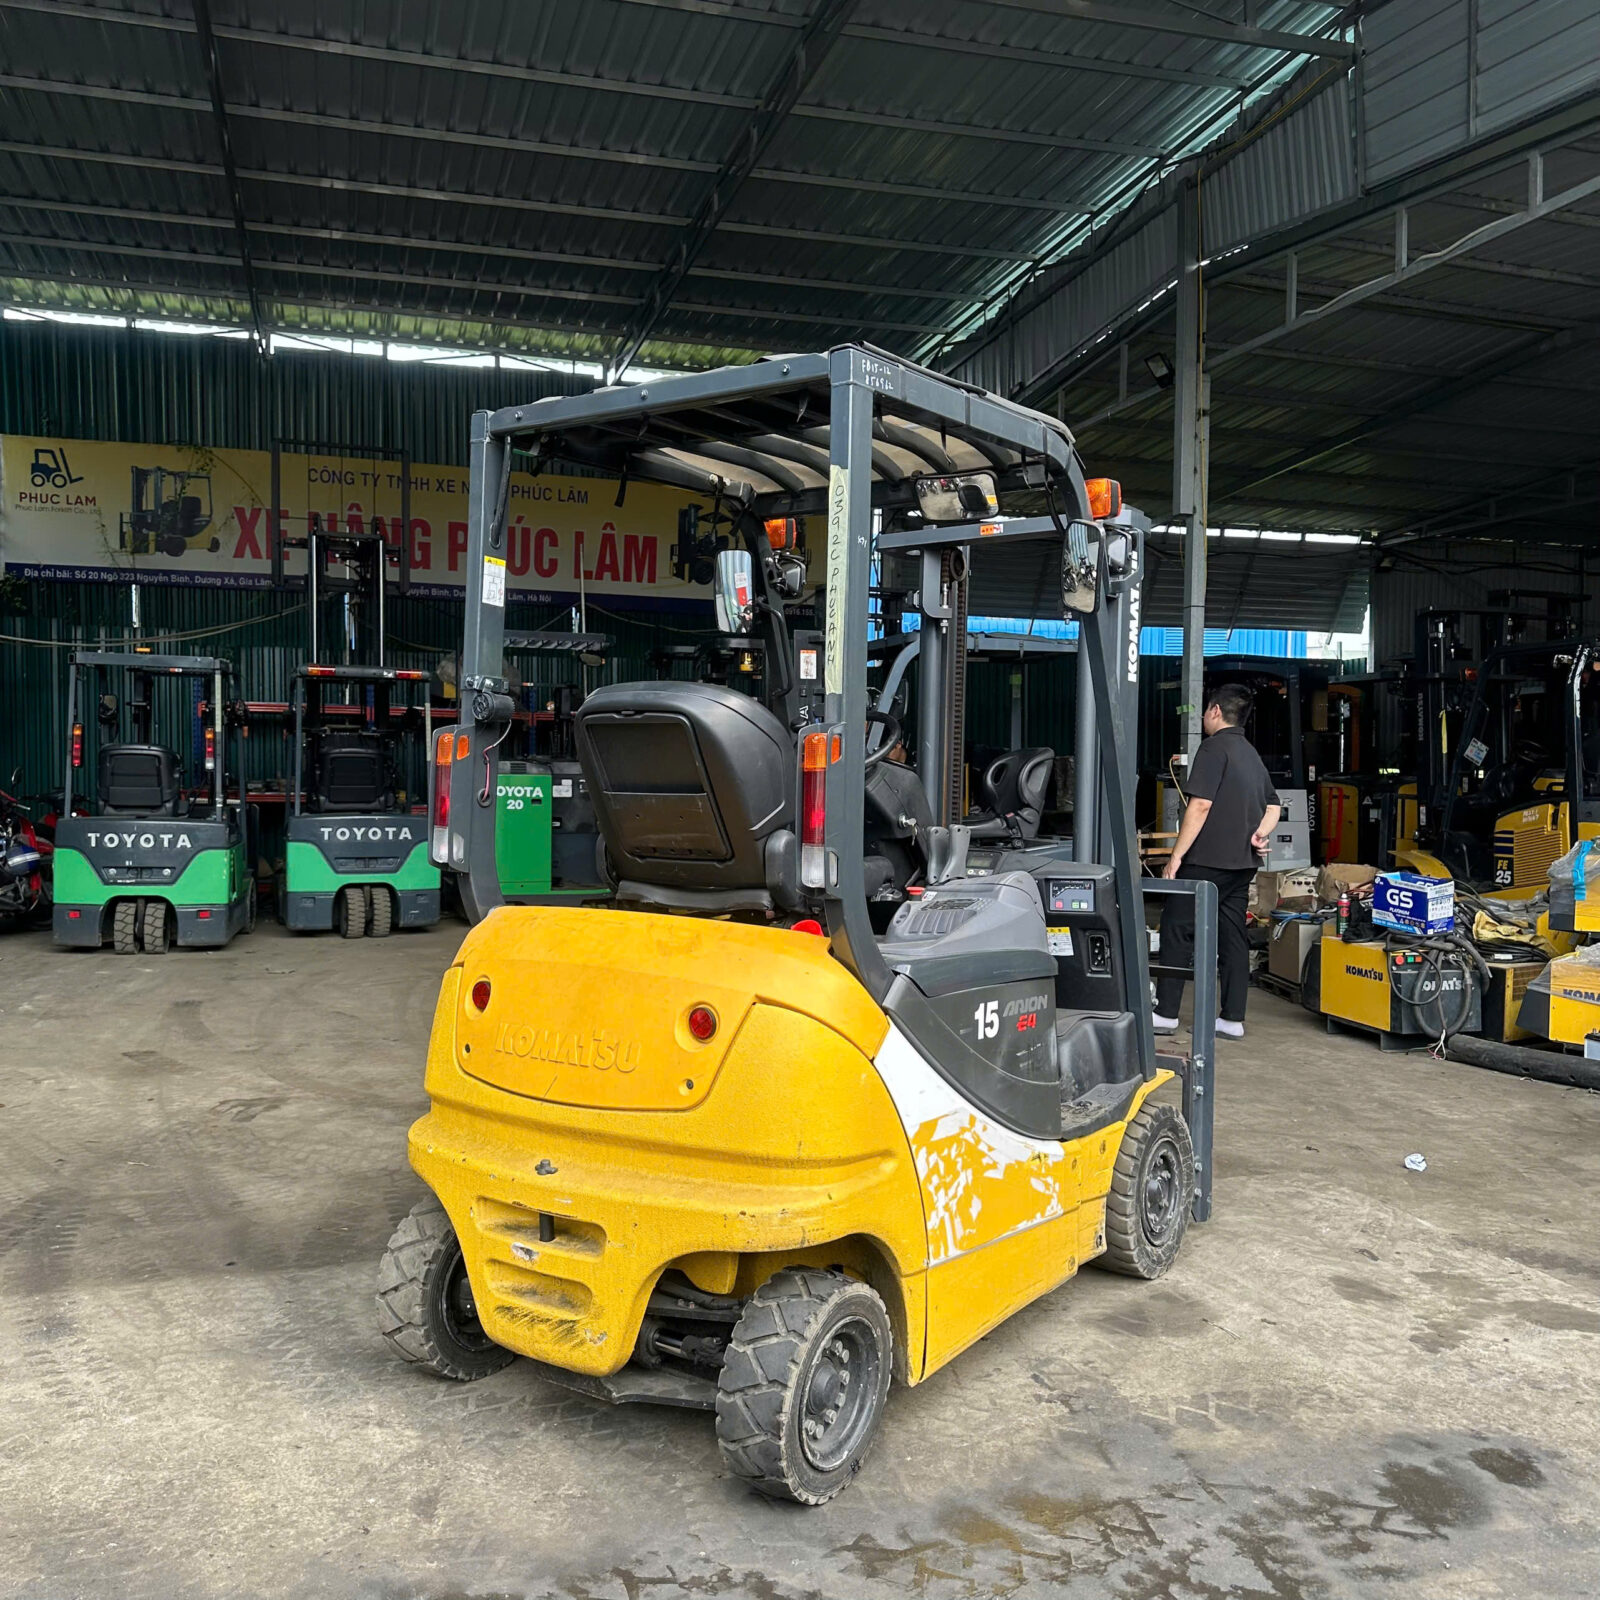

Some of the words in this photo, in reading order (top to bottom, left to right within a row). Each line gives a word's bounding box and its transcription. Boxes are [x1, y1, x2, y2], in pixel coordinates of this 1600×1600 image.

[308, 466, 355, 485] CÔNG
[361, 472, 381, 487] TY
[436, 480, 455, 493] XE
[511, 483, 552, 502] PHÚC
[558, 486, 589, 504] LÂM
[19, 492, 60, 504] PHUC
[66, 494, 97, 506] LAM
[574, 522, 658, 583] LÂM
[24, 568, 39, 578] Địa
[88, 571, 99, 580] 20
[496, 786, 544, 798] OYOTA
[506, 799, 525, 810] 20
[87, 832, 192, 848] TOYOTA
[320, 827, 412, 841] TOYOTA
[1497, 859, 1509, 870] FE
[1495, 870, 1512, 884] 25
[1386, 888, 1414, 909] GS
[1345, 964, 1384, 982] KOMATSU
[974, 1000, 1000, 1040] 15
[495, 1022, 640, 1073] KOMATSU
